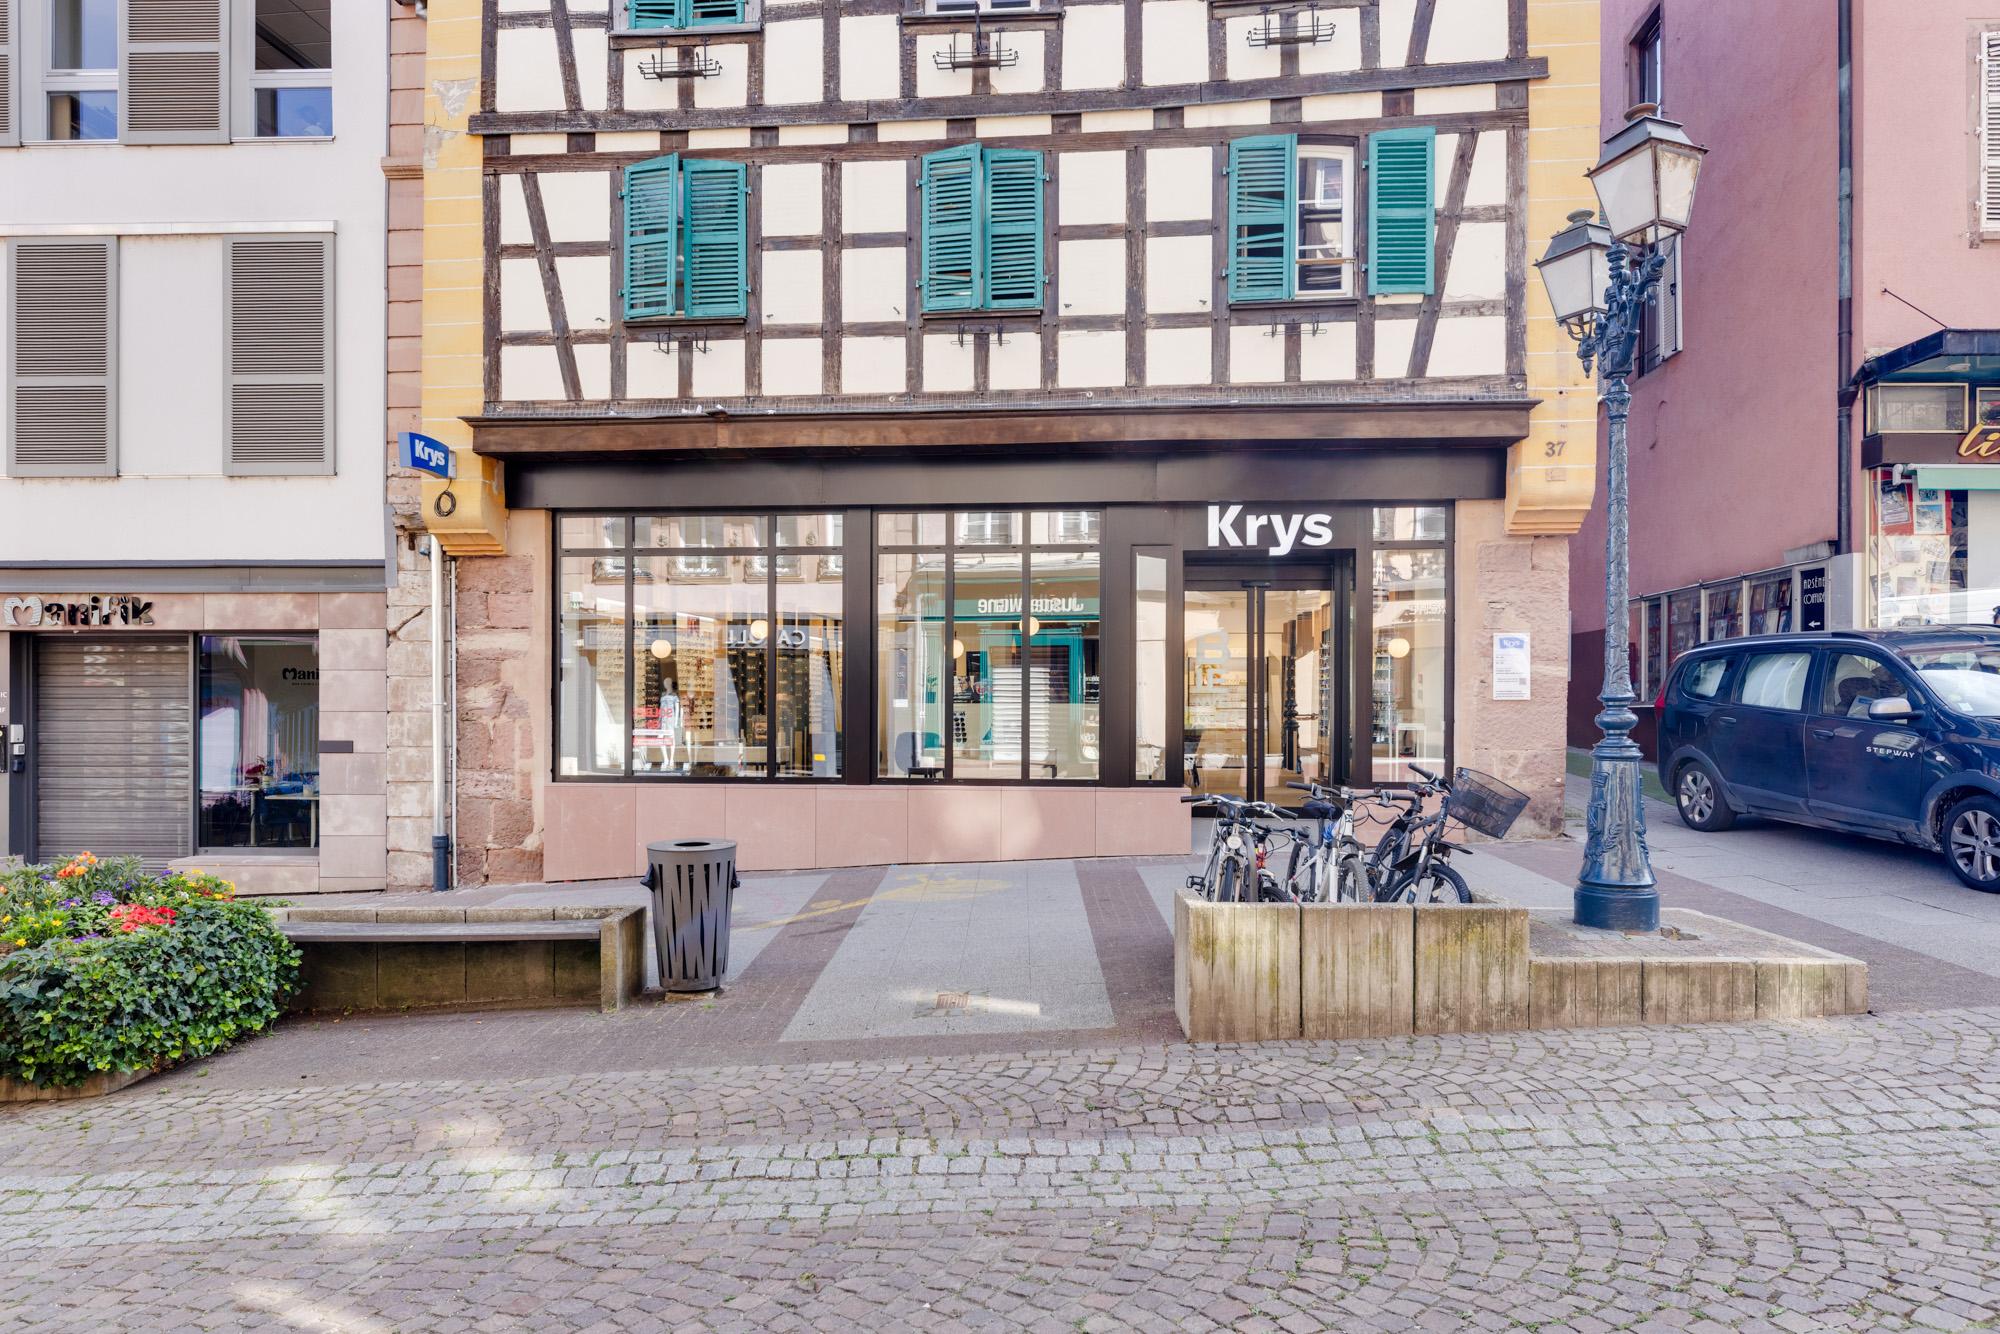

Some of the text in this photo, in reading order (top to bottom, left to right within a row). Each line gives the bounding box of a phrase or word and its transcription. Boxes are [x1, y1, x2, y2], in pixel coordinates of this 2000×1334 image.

[414, 438, 446, 467] Krys
[1544, 440, 1567, 458] 37
[1207, 504, 1334, 557] Krys
[1865, 746, 1915, 758] STEPWAY
